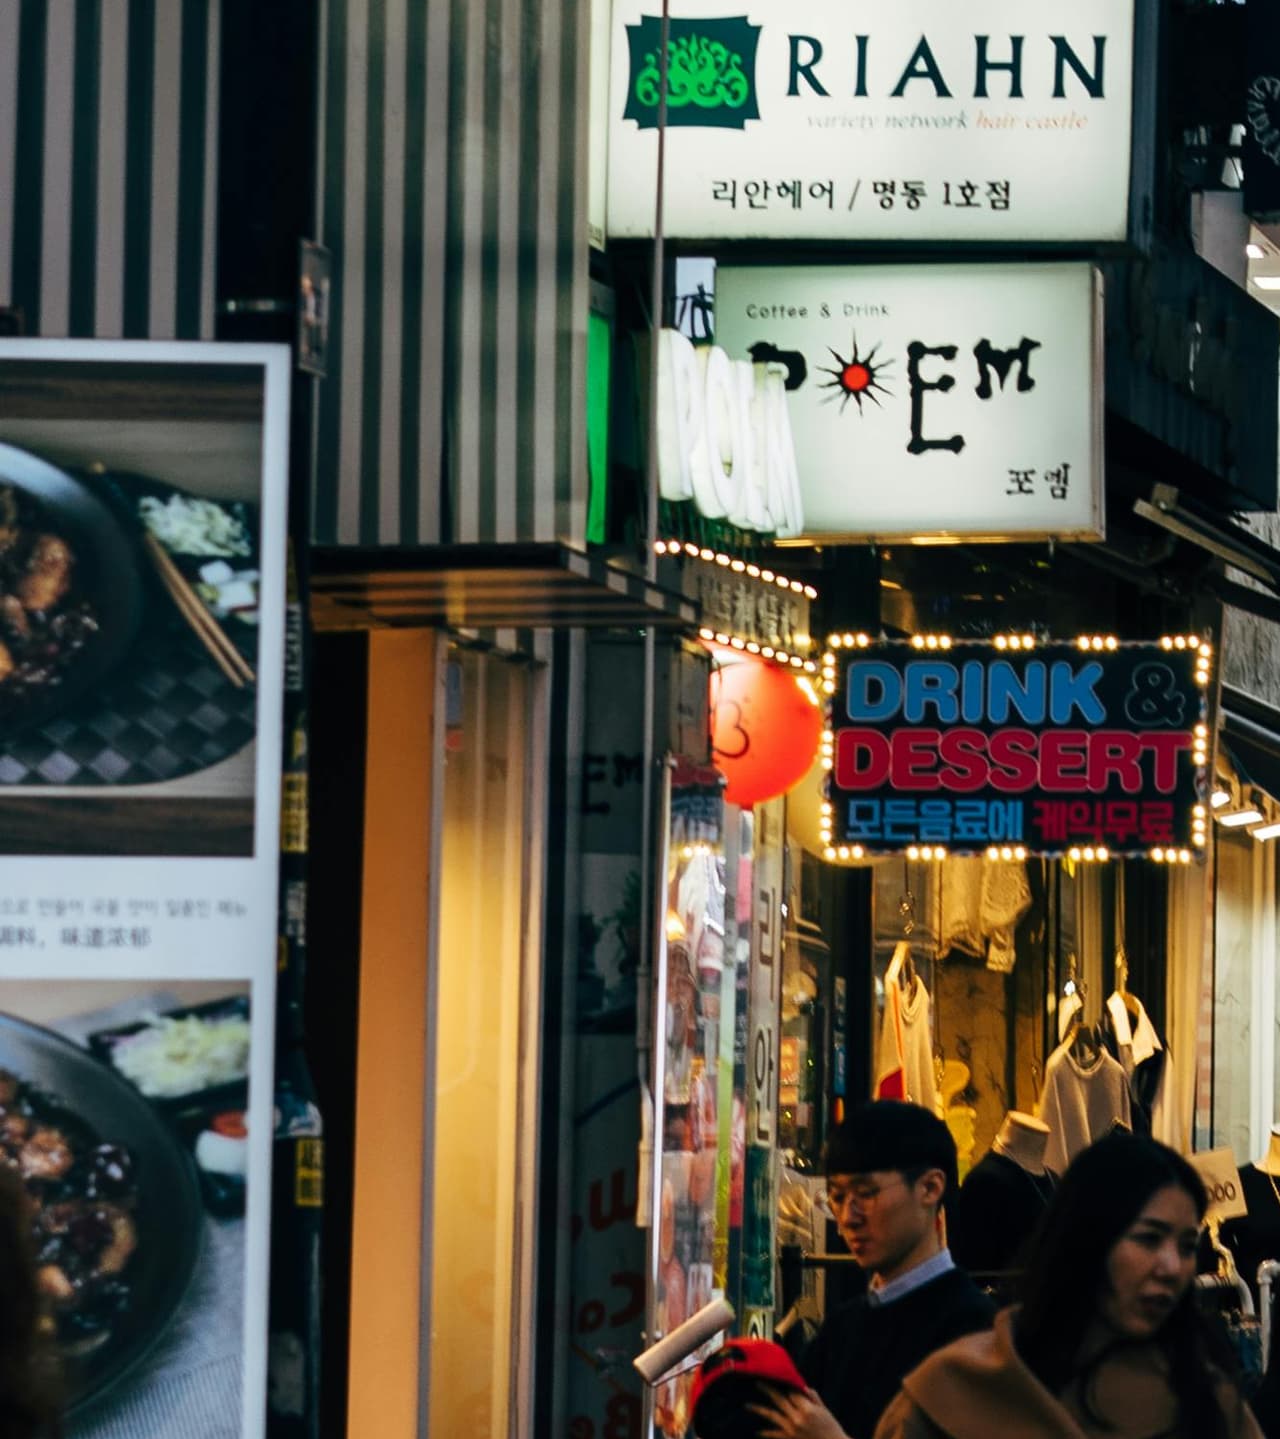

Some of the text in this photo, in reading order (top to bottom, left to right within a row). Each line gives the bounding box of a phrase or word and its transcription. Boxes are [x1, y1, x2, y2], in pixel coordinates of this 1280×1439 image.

[786, 34, 1108, 100] RIAHN
[711, 178, 837, 213] 리안헤어
[870, 178, 929, 213] 명동
[745, 301, 811, 321] Coffee
[841, 300, 892, 320] Drink
[1004, 463, 1073, 501] 포엠
[846, 659, 1185, 726] DRINK &
[835, 728, 1193, 794] DESSERT
[846, 798, 1176, 844] 모든음료에 케익무료
